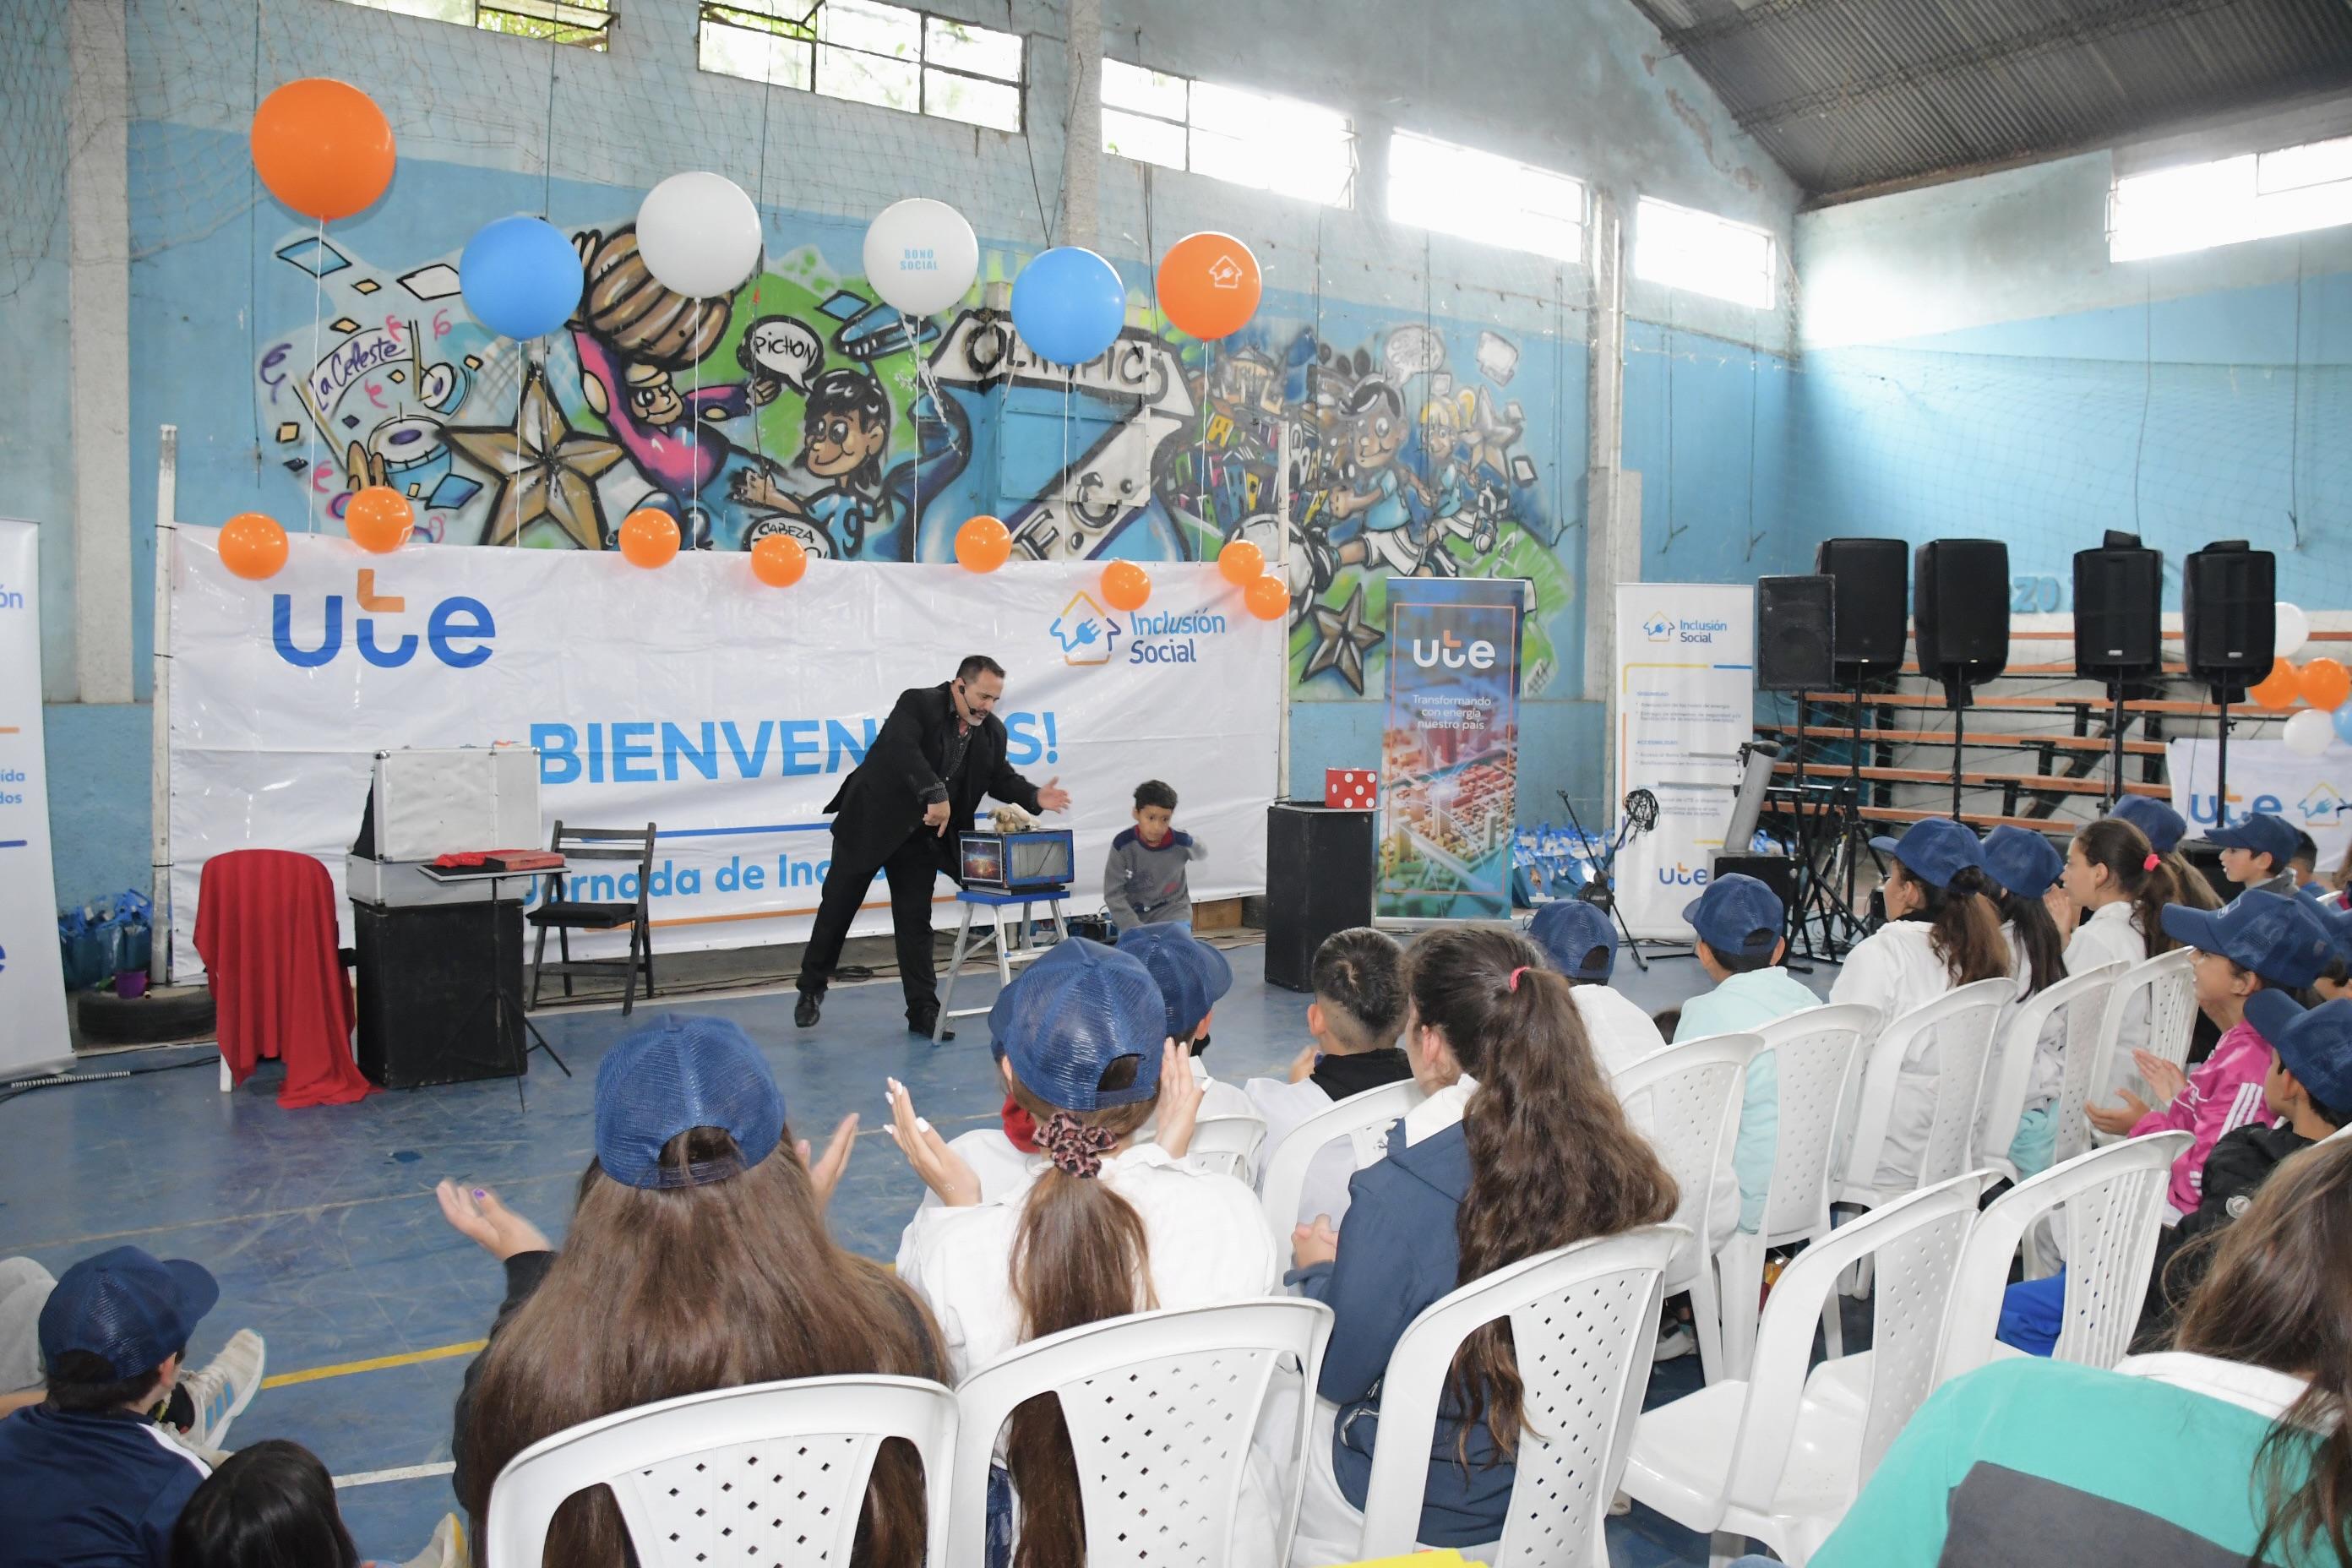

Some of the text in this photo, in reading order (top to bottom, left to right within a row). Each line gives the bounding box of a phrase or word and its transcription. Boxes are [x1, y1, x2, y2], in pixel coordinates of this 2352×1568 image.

[900, 260, 939, 270] SOCIAL
[905, 249, 934, 259] BONO
[331, 337, 406, 387] Celeste
[758, 521, 815, 544] CABEZA
[273, 569, 495, 668] ute
[1130, 607, 1225, 635] Inclusión
[1680, 619, 1728, 631] Inclusión
[1413, 629, 1495, 669] ute
[1680, 632, 1712, 643] Social
[1129, 639, 1196, 664] Social
[1413, 694, 1492, 706] Transformando
[1417, 719, 1484, 731] nuestro país
[1422, 707, 1481, 720] con energía
[531, 710, 1058, 784] BIENVENS!
[716, 855, 765, 892] de
[1659, 862, 1708, 885] ute
